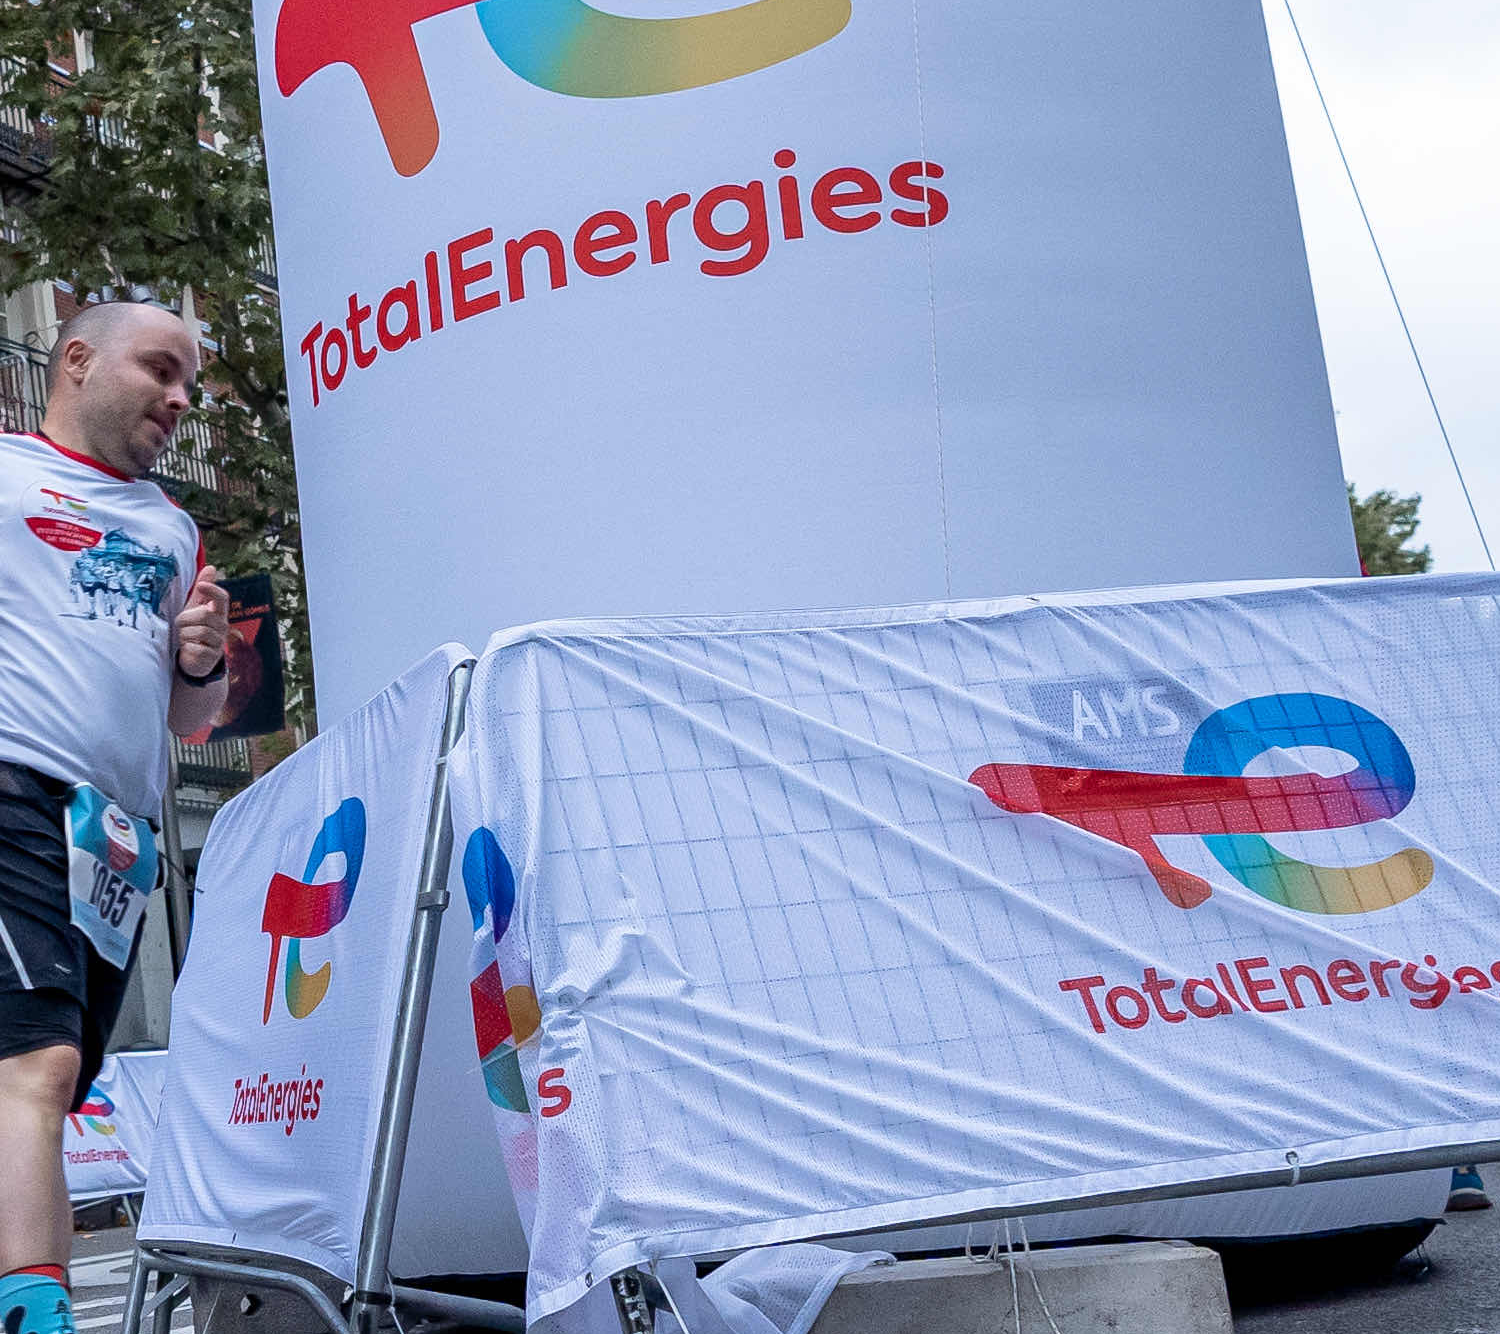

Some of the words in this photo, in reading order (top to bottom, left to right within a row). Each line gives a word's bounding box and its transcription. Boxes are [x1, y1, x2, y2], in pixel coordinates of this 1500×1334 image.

[301, 149, 949, 407] TotalEnergies
[1071, 684, 1181, 740] AMS
[227, 1064, 323, 1137] TotalEnergies
